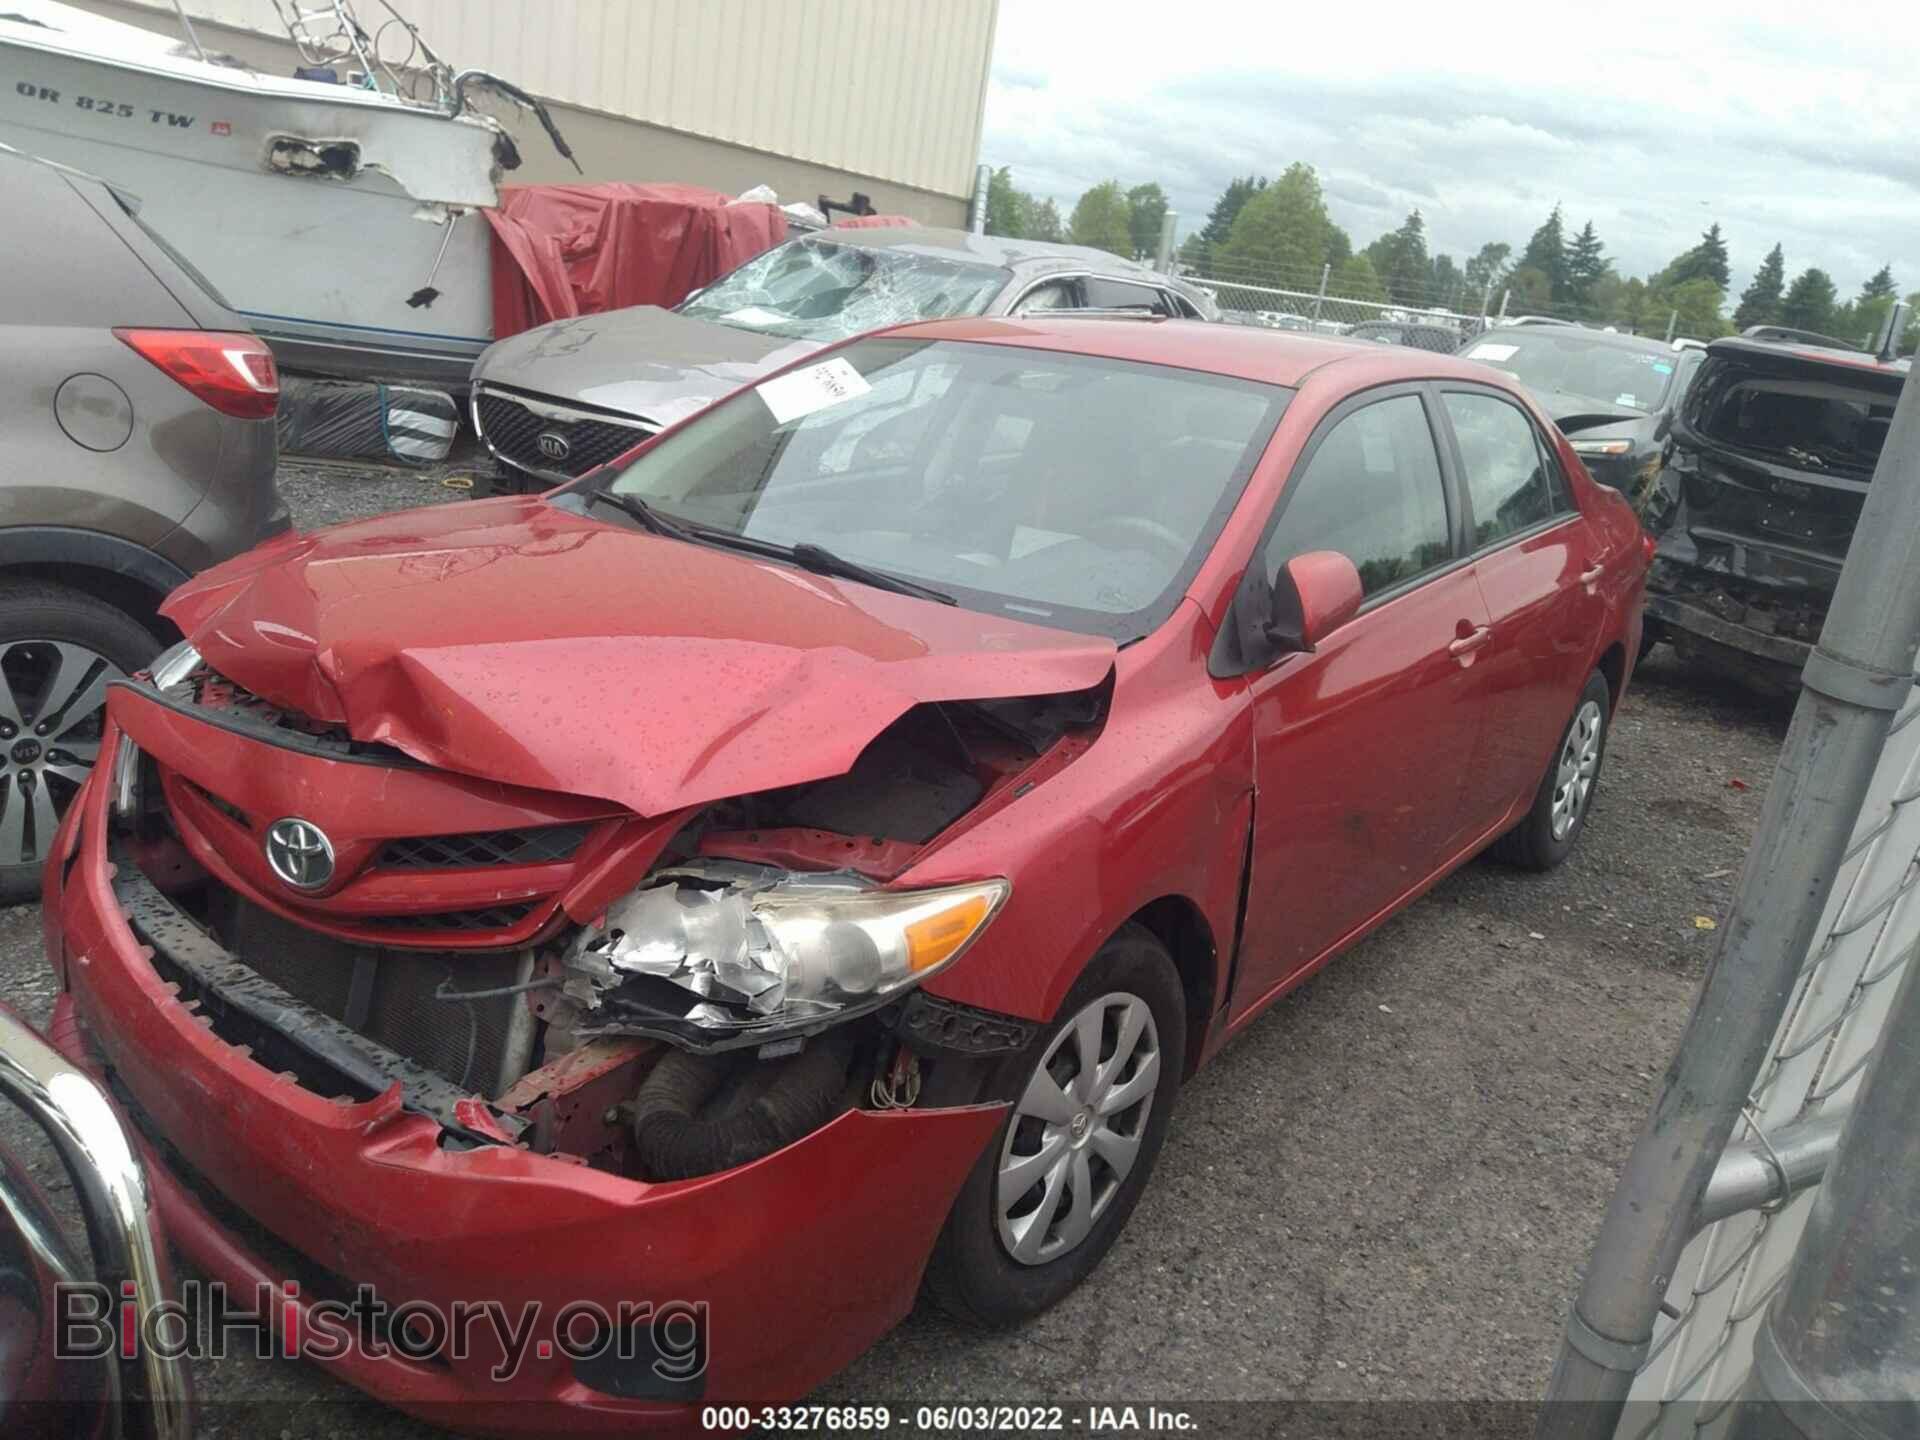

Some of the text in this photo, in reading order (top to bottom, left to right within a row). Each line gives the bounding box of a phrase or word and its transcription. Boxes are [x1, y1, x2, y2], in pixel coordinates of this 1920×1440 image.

[16, 81, 196, 128] OR 825 TW
[540, 437, 565, 456] KIA
